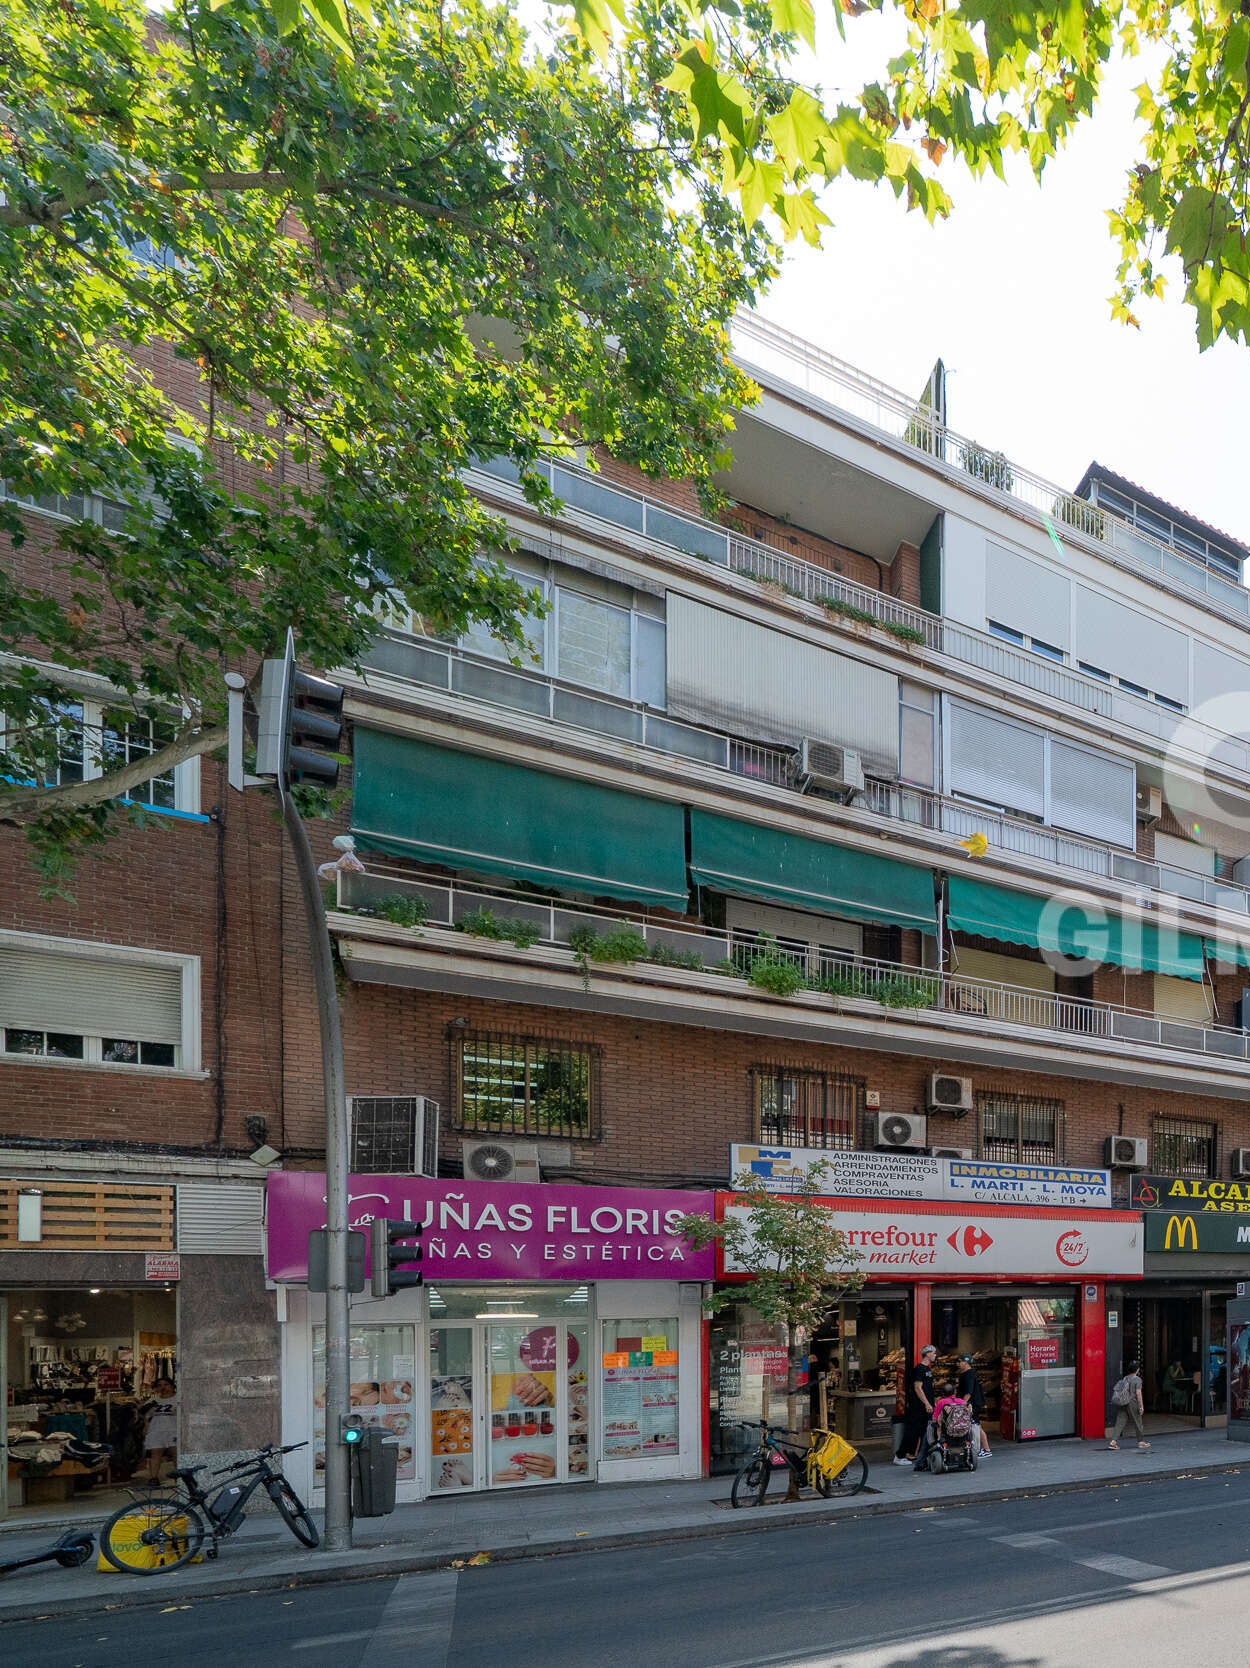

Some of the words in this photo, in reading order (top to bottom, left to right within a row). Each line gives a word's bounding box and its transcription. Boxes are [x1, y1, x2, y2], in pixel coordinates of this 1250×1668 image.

[833, 1153, 937, 1166] ADMINISTRACIONES
[834, 1162, 938, 1174] ARRENDAMIENTOS
[952, 1165, 1104, 1184] INMOBILIARIA
[833, 1169, 925, 1182] COMPRAVENTAS
[833, 1178, 889, 1188] ASESORIA
[950, 1178, 964, 1188] L.
[971, 1179, 1024, 1191] MARTI
[1043, 1184, 1055, 1193] L.
[1060, 1185, 1107, 1196] MOYA
[834, 1186, 923, 1197] VALORACIONES
[1036, 1195, 1050, 1203] 396
[403, 1193, 533, 1232] UÑAS
[547, 1205, 687, 1236] FLORIS
[838, 1225, 938, 1248] arrefour
[402, 1237, 492, 1260] ÑAS
[510, 1243, 527, 1260] Y
[544, 1240, 685, 1262] ESTÉTICA
[1063, 1241, 1084, 1255] 24/7
[870, 1249, 937, 1265] market
[1030, 1344, 1056, 1352] Horario
[720, 1350, 729, 1361] 2
[108, 1542, 142, 1553] lovo
